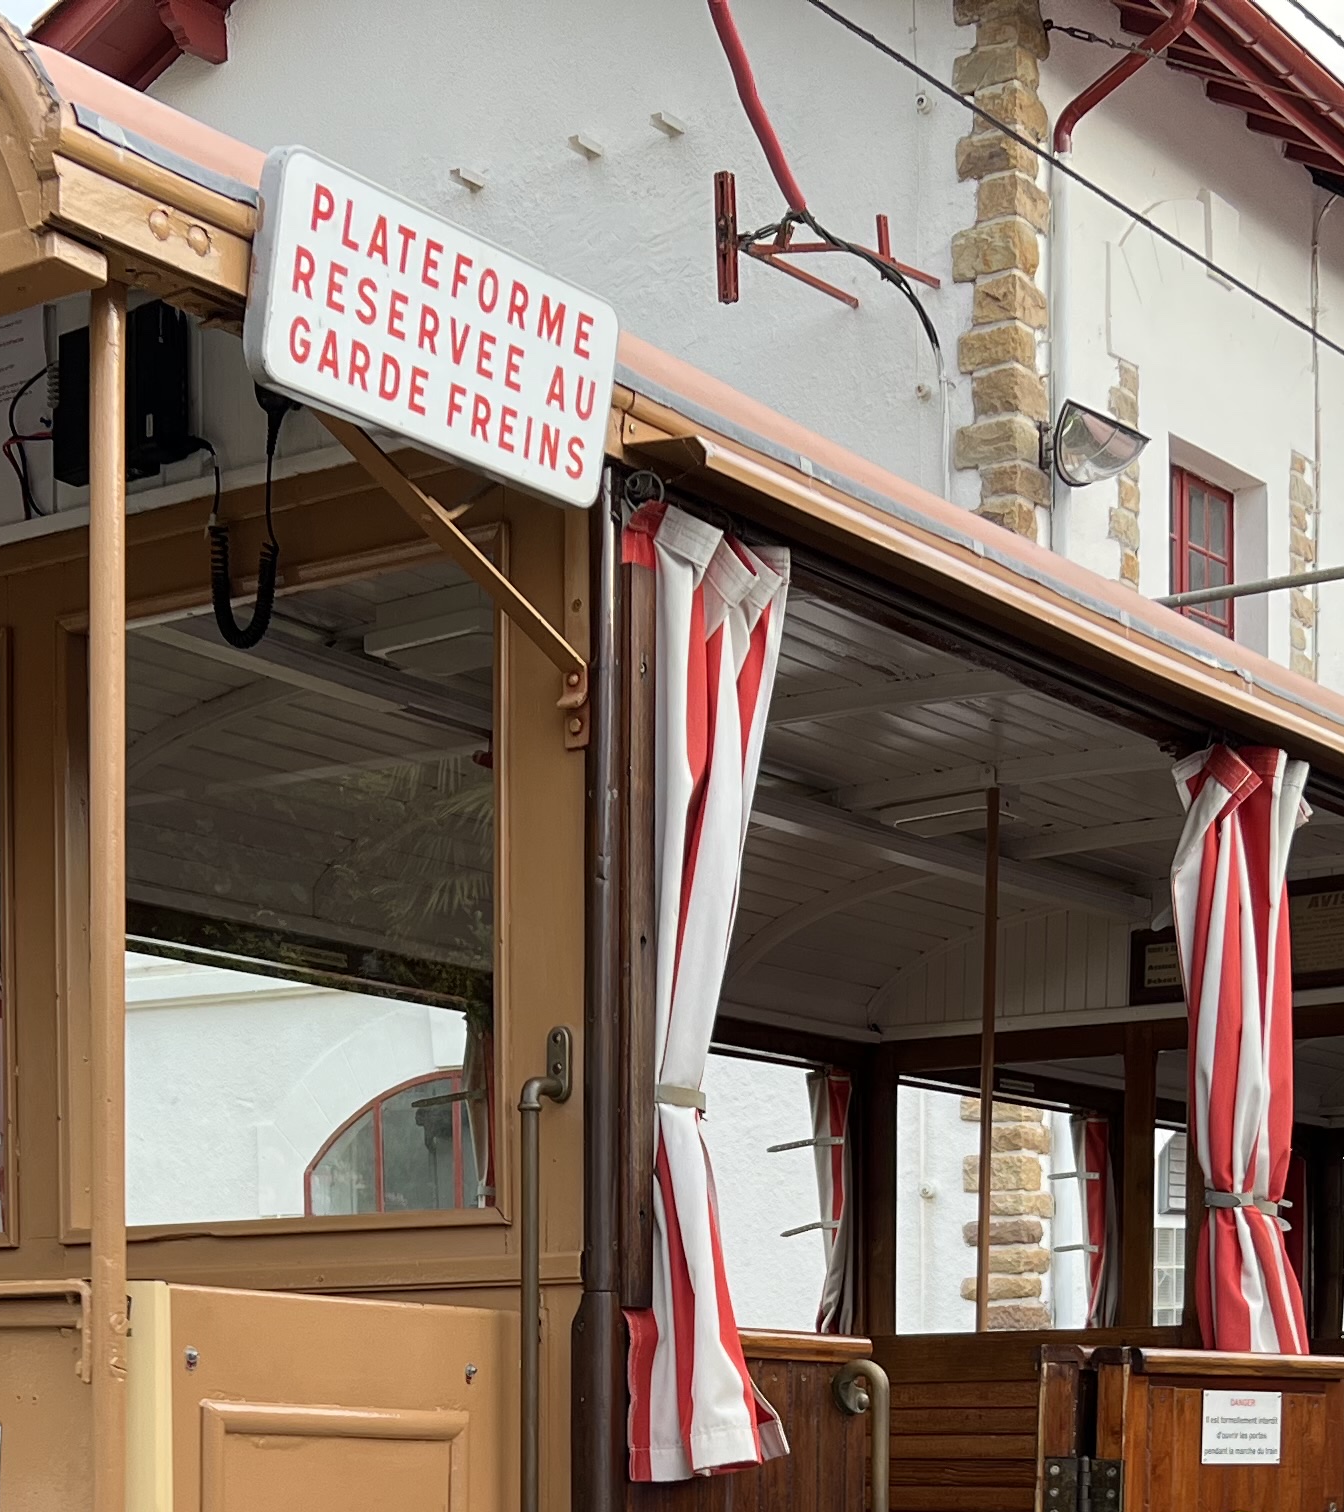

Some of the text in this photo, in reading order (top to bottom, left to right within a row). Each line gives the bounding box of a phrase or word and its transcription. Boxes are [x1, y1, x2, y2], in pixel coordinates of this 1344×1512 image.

[292, 245, 596, 422] RESERVEE AU
[310, 183, 595, 361] PLATEFORME
[289, 316, 586, 480] GARDE FREINS
[1230, 1398, 1256, 1407] DANGER
